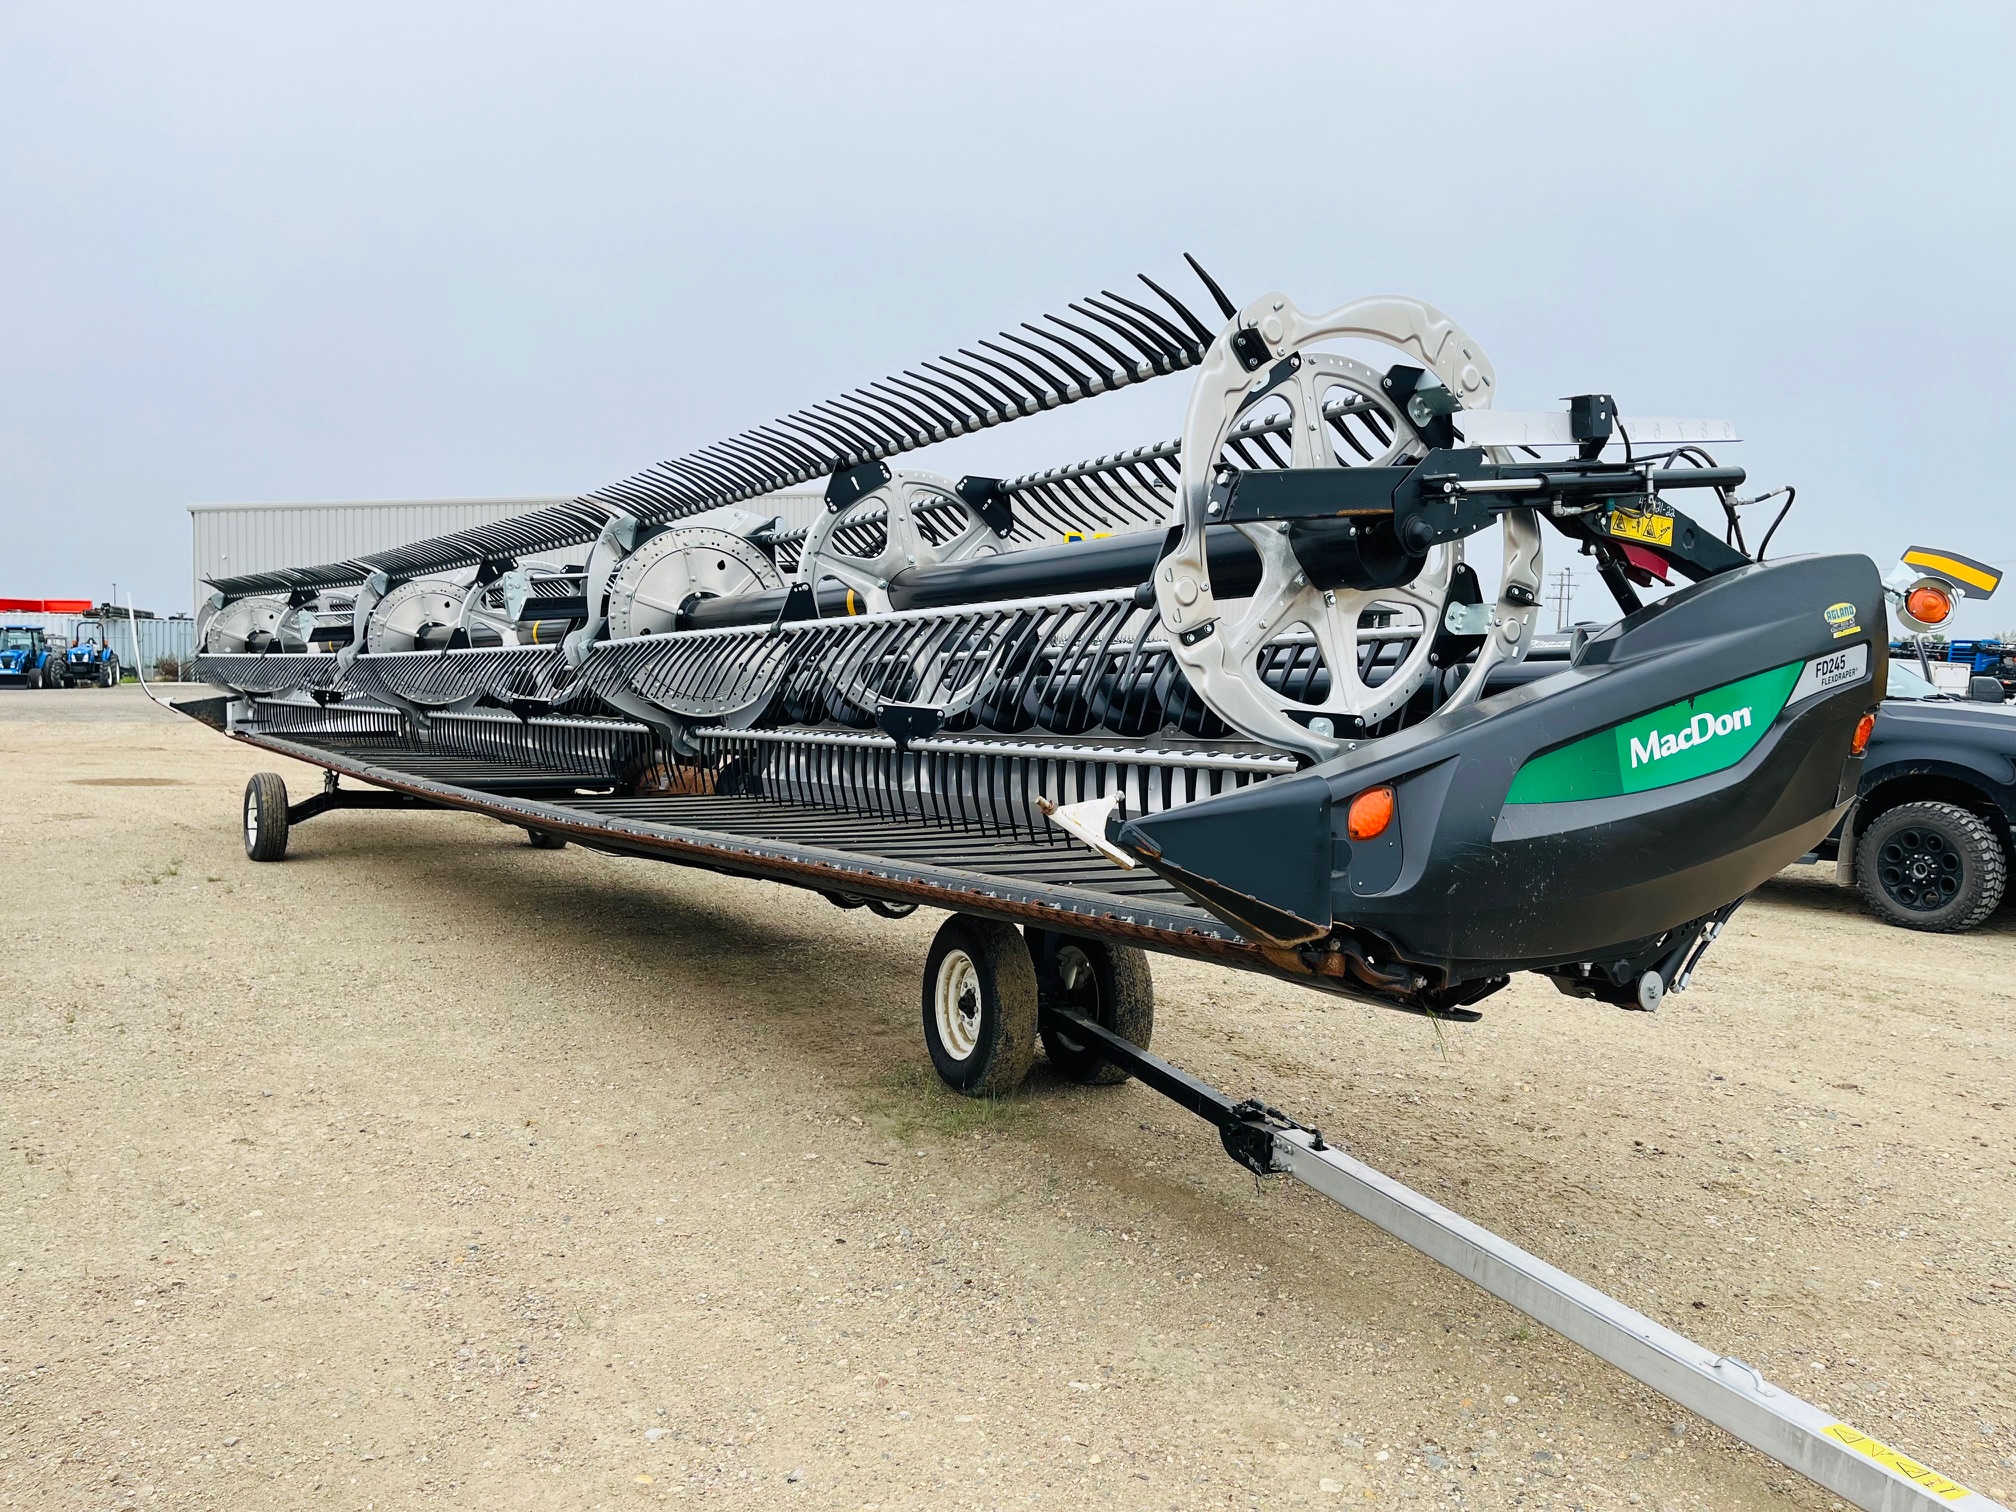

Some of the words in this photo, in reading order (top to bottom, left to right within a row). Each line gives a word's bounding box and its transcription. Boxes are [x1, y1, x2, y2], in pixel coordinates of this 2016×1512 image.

[1825, 605, 1855, 622] AGLAND
[1815, 654, 1847, 679] FD245
[1629, 706, 1752, 768] MacDon
